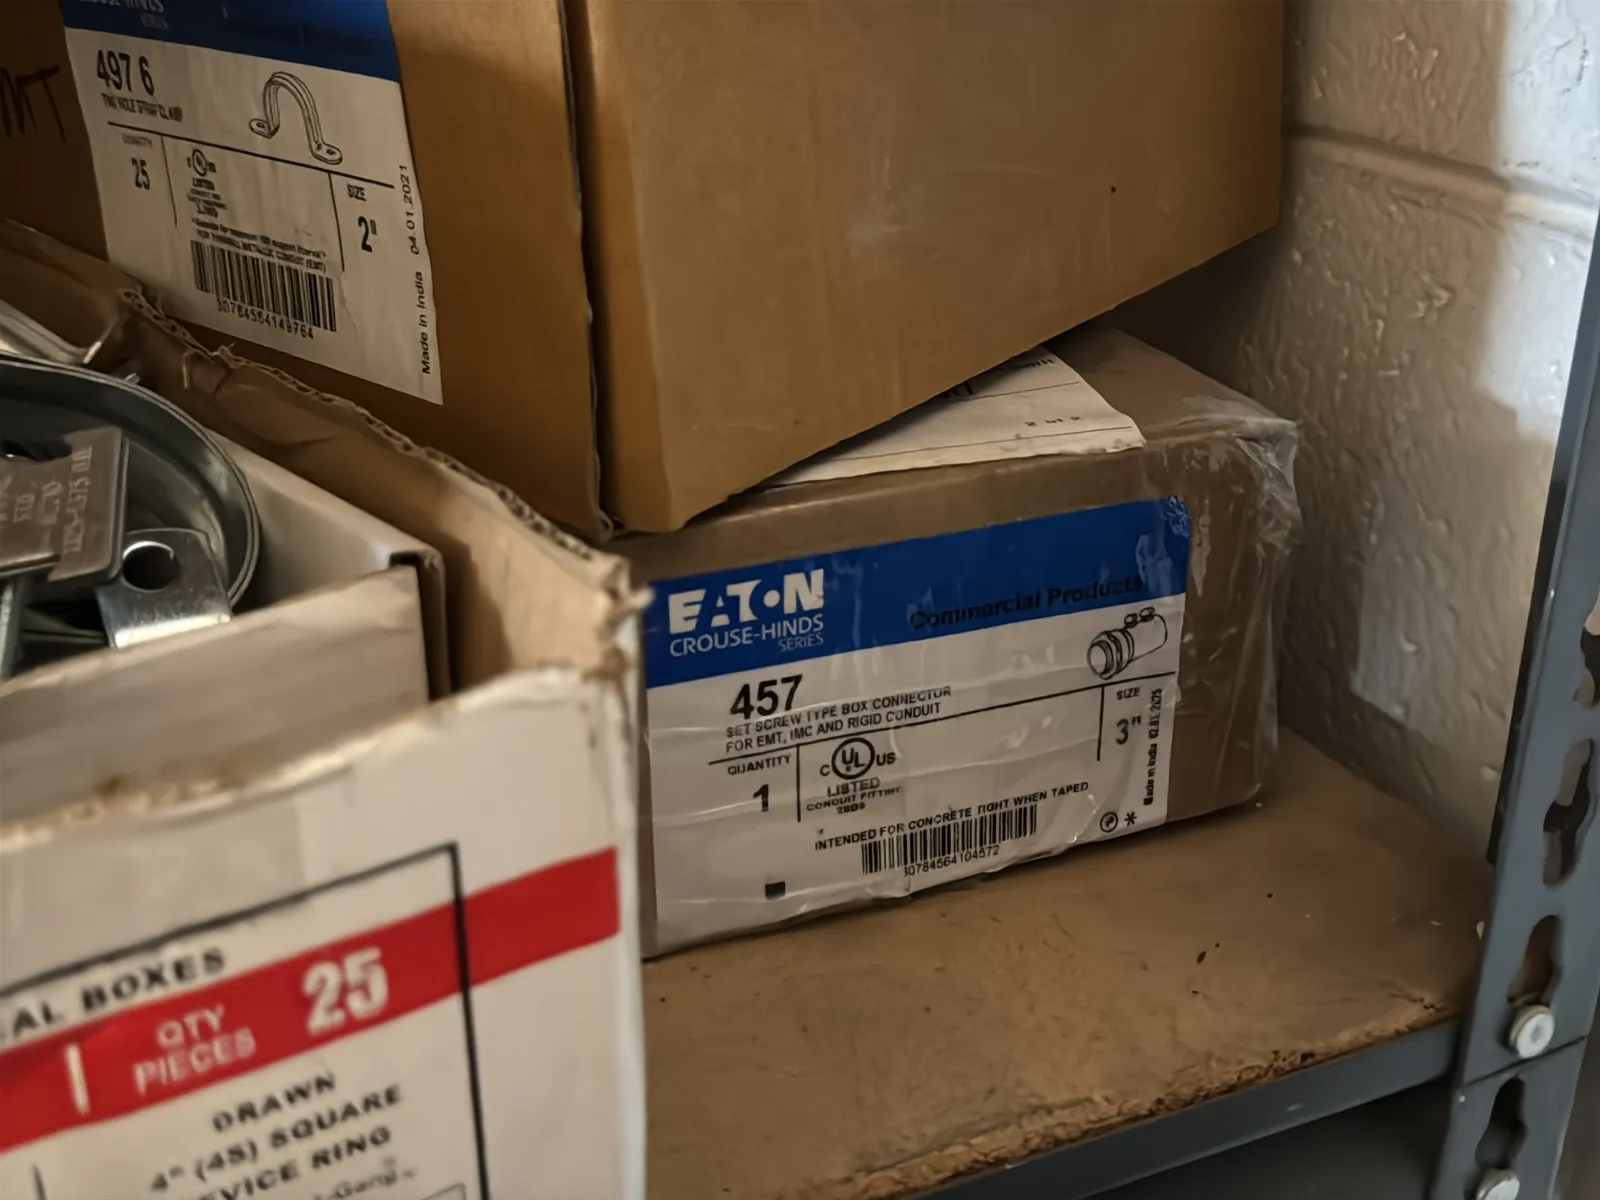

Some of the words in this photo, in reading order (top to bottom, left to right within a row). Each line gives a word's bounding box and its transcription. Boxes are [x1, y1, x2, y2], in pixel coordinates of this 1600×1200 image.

[131, 157, 150, 190] 25
[415, 271, 427, 309] India
[419, 314, 428, 328] in
[422, 333, 431, 374] Made
[909, 588, 1041, 630] Commercial
[1046, 577, 1143, 609] Products
[669, 613, 825, 658] CROUSE-HINDS
[778, 632, 824, 652] SERIES
[726, 722, 750, 738] SET
[755, 712, 801, 732] SCREW
[806, 703, 838, 722] TYPE
[841, 700, 869, 716] BOX
[872, 686, 951, 710] CONNECTOR
[730, 674, 803, 720] 457
[1116, 687, 1141, 700] SIZE
[726, 736, 754, 754] FOR
[756, 732, 787, 748] EMT,
[790, 725, 813, 741] IMC
[816, 719, 844, 735] AND
[847, 712, 882, 729] RIGID
[886, 702, 941, 723] CONDUIT
[727, 754, 791, 776] QUANTITY
[827, 777, 880, 797] LISTED
[752, 784, 770, 812] 1
[806, 794, 856, 811] CONDUIT
[814, 829, 876, 851] INTENDED
[879, 822, 904, 837] FOR
[908, 807, 972, 830] CONCRETE
[978, 799, 1010, 814] TIGHT
[1013, 791, 1047, 806] WHEN
[1051, 781, 1089, 797] TAPED
[0, 1000, 64, 1040] AL
[81, 948, 225, 1013] BOXES
[157, 1003, 226, 1050] QTY
[303, 946, 388, 1036] 25
[133, 1027, 256, 1096] PIECES
[211, 1069, 338, 1135] DRAWN
[268, 1083, 403, 1150] SQUARE
[310, 1124, 393, 1170] RING
